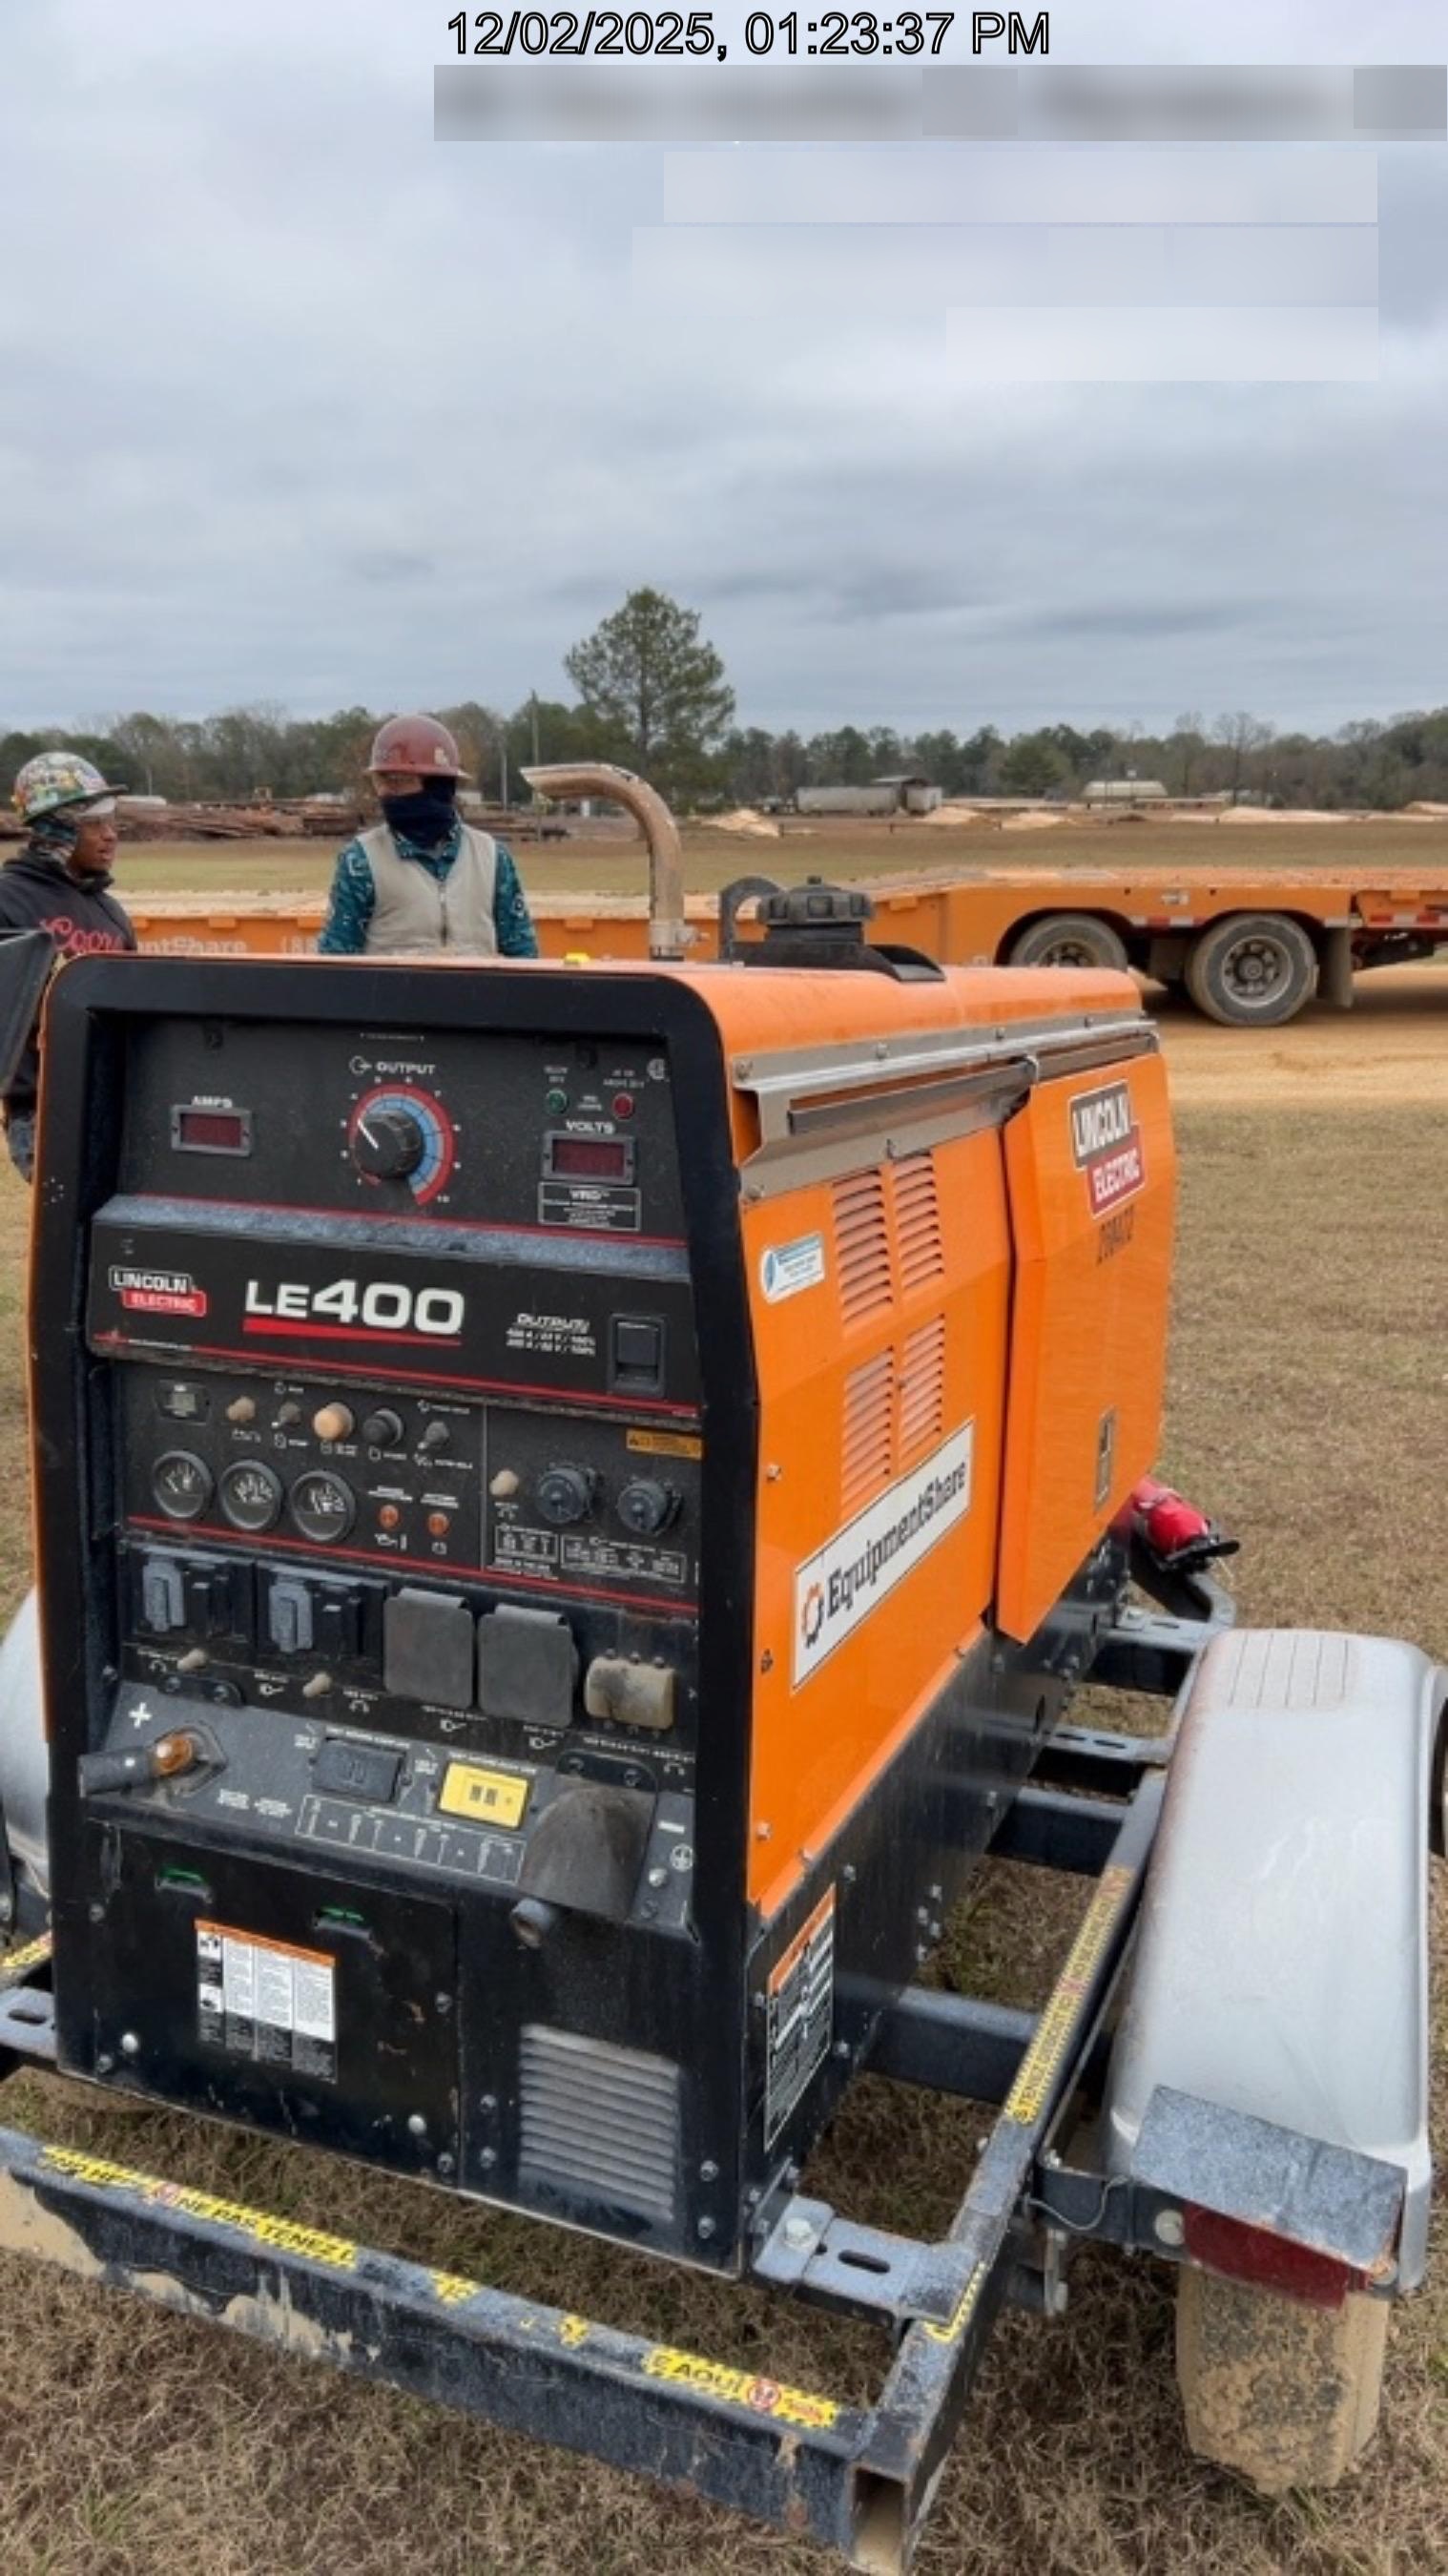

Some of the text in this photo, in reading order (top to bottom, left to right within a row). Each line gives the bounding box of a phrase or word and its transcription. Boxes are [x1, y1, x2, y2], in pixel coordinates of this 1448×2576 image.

[376, 1061, 436, 1074] OUTPUT
[565, 1119, 615, 1135] VOLTS
[1073, 1091, 1130, 1158] LINCOLN
[1092, 1146, 1141, 1203] ELECTRIC
[114, 1271, 189, 1295] LINCOLN
[130, 1293, 197, 1312] ELECTRIC
[244, 1278, 465, 1335] LE400
[827, 1462, 966, 1620] EquipmentShare
